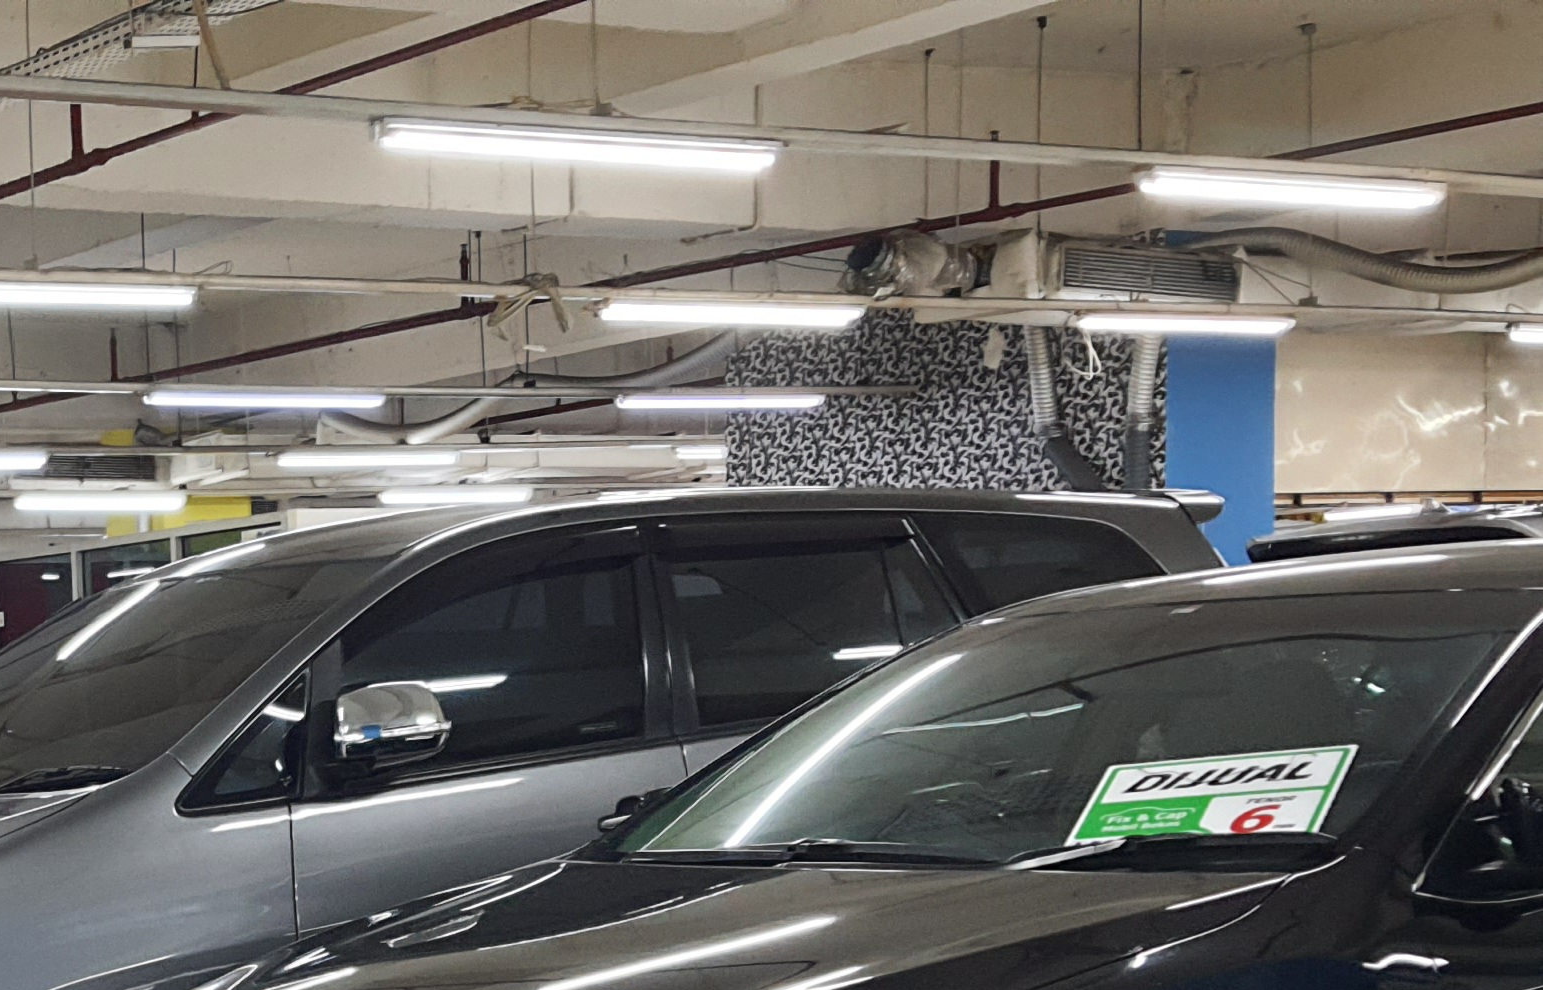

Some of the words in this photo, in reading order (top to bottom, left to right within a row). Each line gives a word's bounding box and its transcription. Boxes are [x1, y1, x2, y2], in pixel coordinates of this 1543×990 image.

[1122, 761, 1314, 794] DIJUAL
[1106, 815, 1132, 825] Fix
[1136, 813, 1149, 822] &
[1229, 804, 1282, 834] 6
